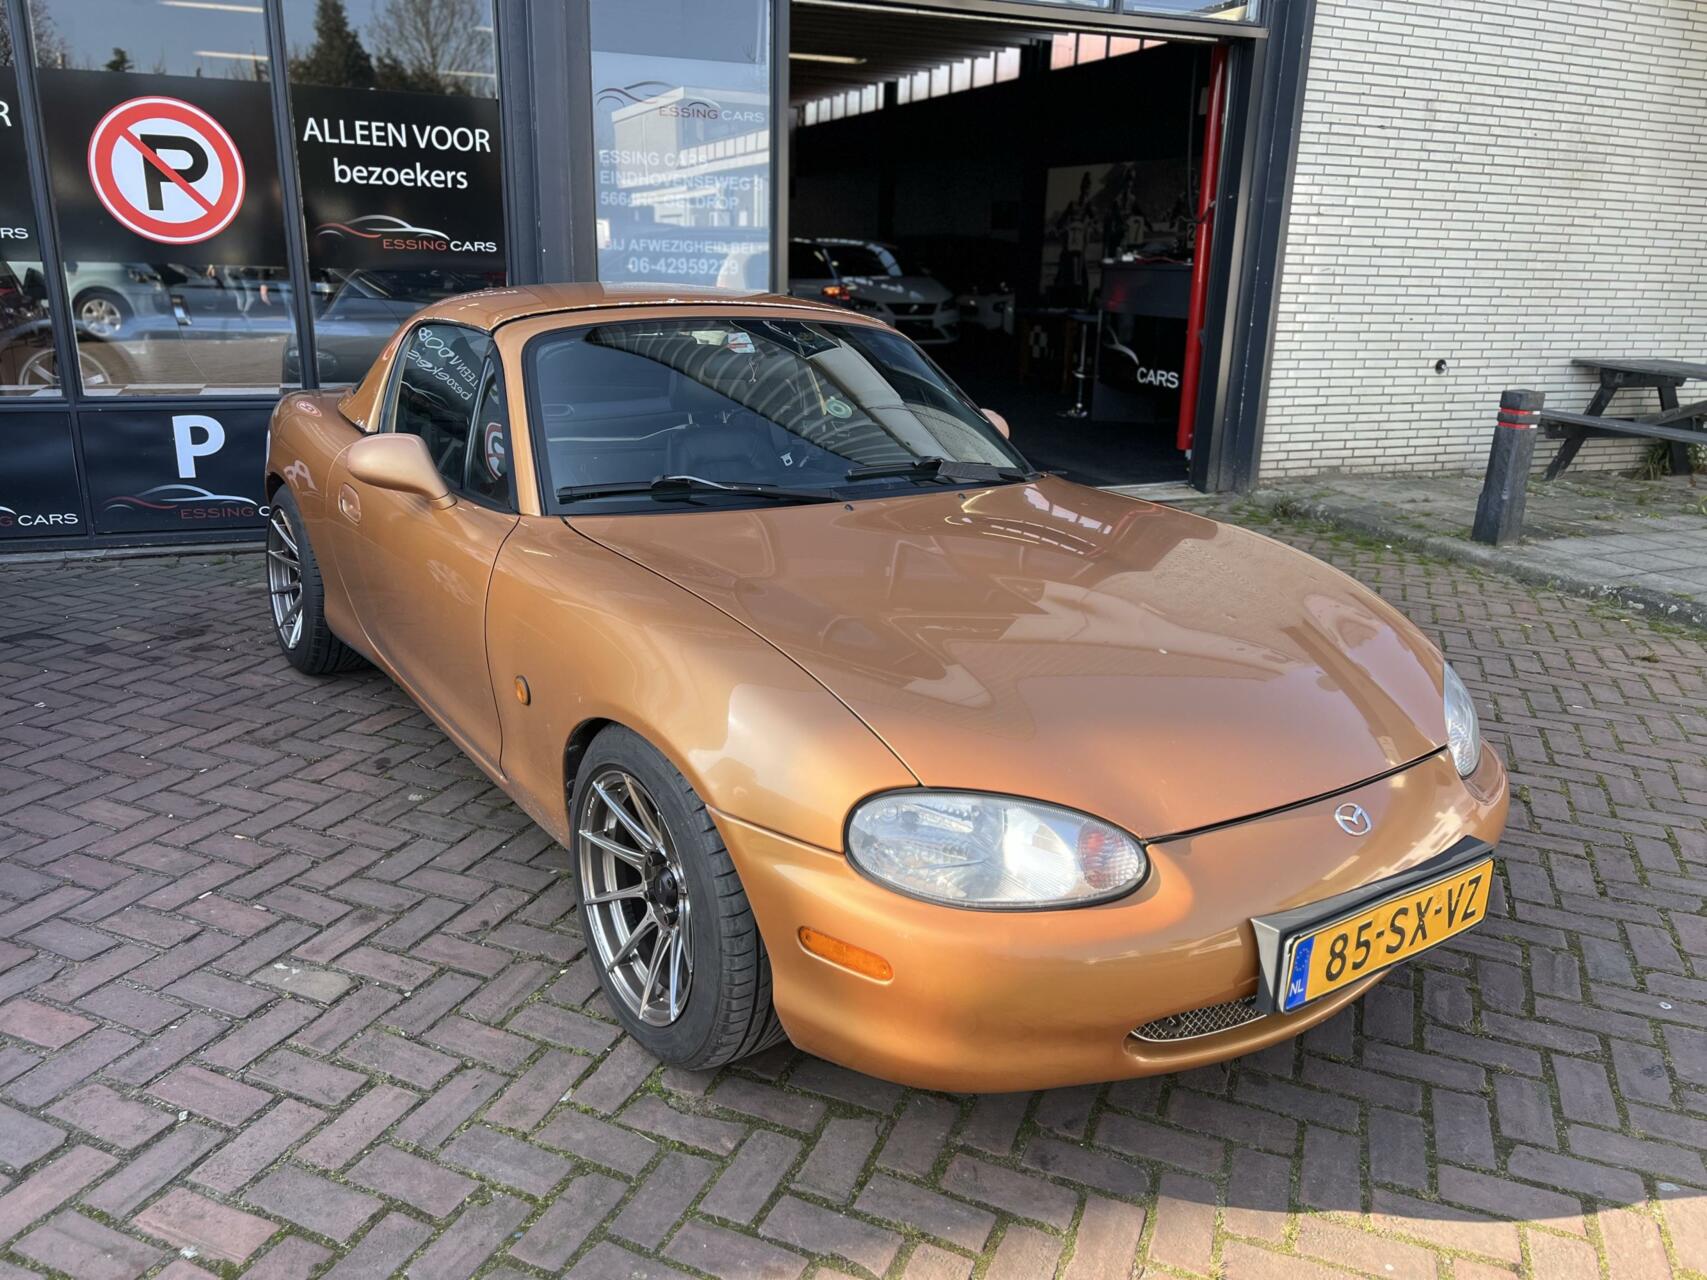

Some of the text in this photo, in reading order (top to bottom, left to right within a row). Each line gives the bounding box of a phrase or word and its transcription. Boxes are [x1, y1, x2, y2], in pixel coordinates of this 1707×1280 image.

[659, 106, 765, 123] ESSING CARS
[303, 117, 491, 152] ALLEEN VOOR
[599, 149, 659, 166] ESSING
[333, 157, 468, 189] bezoekers
[600, 170, 750, 190] EINDHOVENSEWEG
[383, 239, 497, 252] ESSING CARS
[628, 239, 726, 253] AFWEZIGHEID
[1136, 366, 1179, 388] CARS
[172, 415, 226, 478] P
[17, 513, 79, 527] CARS
[179, 506, 256, 520] ESSING
[1325, 873, 1484, 982] 85-SX-VZ
[1289, 980, 1304, 996] NL
